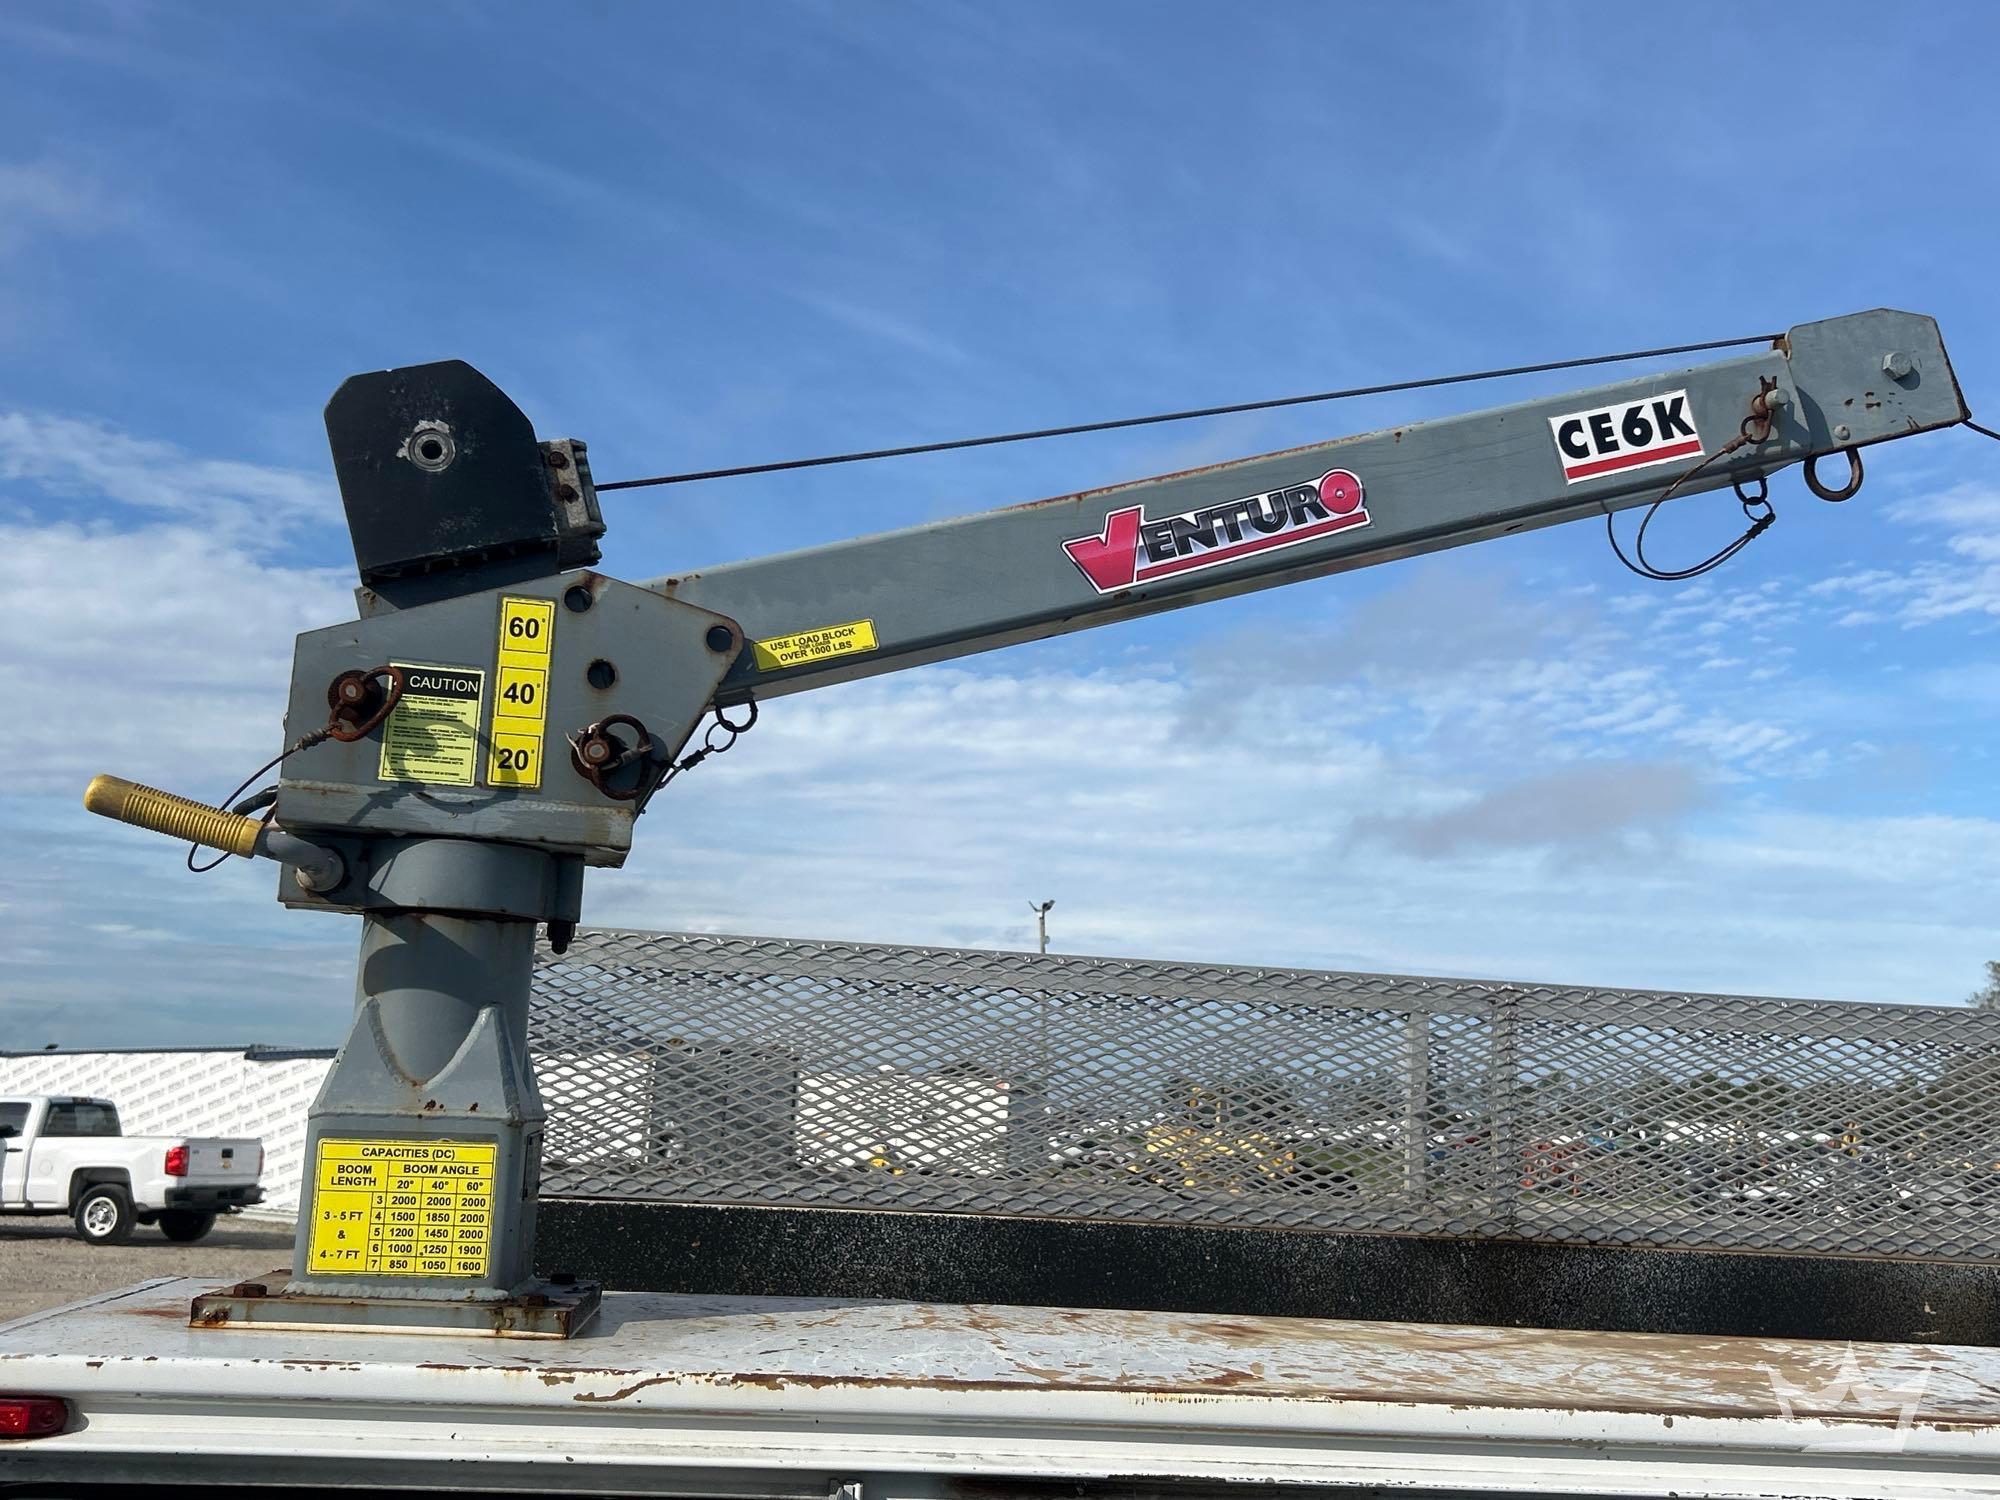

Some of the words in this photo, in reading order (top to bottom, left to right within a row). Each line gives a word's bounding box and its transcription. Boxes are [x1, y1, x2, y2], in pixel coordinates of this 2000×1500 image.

[1558, 396, 1696, 459] CE6K
[1064, 470, 1363, 591] VENTURO
[770, 641, 791, 650] USE
[793, 635, 820, 646] LOAD
[822, 628, 856, 640] BLOCK
[780, 649, 808, 661] OVER
[811, 645, 831, 655] 1000
[834, 641, 852, 650] LBS
[409, 675, 479, 693] CAUTION
[361, 1147, 429, 1158] CAPACITIES
[432, 1149, 455, 1161] (DC)
[337, 1164, 372, 1174] BOOM
[403, 1164, 438, 1174] BOOM
[441, 1165, 480, 1175] ANGLE
[331, 1176, 377, 1187] LENGTH
[397, 1180, 414, 1189] 20°
[431, 1181, 449, 1190] 40°
[466, 1182, 483, 1191] 60°
[377, 1195, 383, 1204] 3
[391, 1196, 416, 1205] 2000
[426, 1197, 451, 1206] 2000
[461, 1198, 486, 1207] 2000
[350, 1211, 363, 1221] FT
[375, 1211, 382, 1221] 4
[391, 1212, 415, 1221] 1500
[426, 1213, 450, 1222] 1850
[460, 1214, 485, 1223] 2000
[337, 1230, 346, 1239] &
[374, 1227, 380, 1236] 5
[389, 1228, 414, 1237] 1200
[424, 1229, 449, 1238] 1450
[459, 1230, 483, 1239] 2000
[346, 1250, 360, 1259] FT
[372, 1244, 379, 1252] 6
[388, 1244, 412, 1253] 1000
[423, 1245, 447, 1254] 1250
[458, 1246, 482, 1255] 1900
[371, 1259, 378, 1268] 7
[389, 1259, 408, 1269] 850
[421, 1261, 446, 1269] 1050
[457, 1261, 481, 1271] 1600
